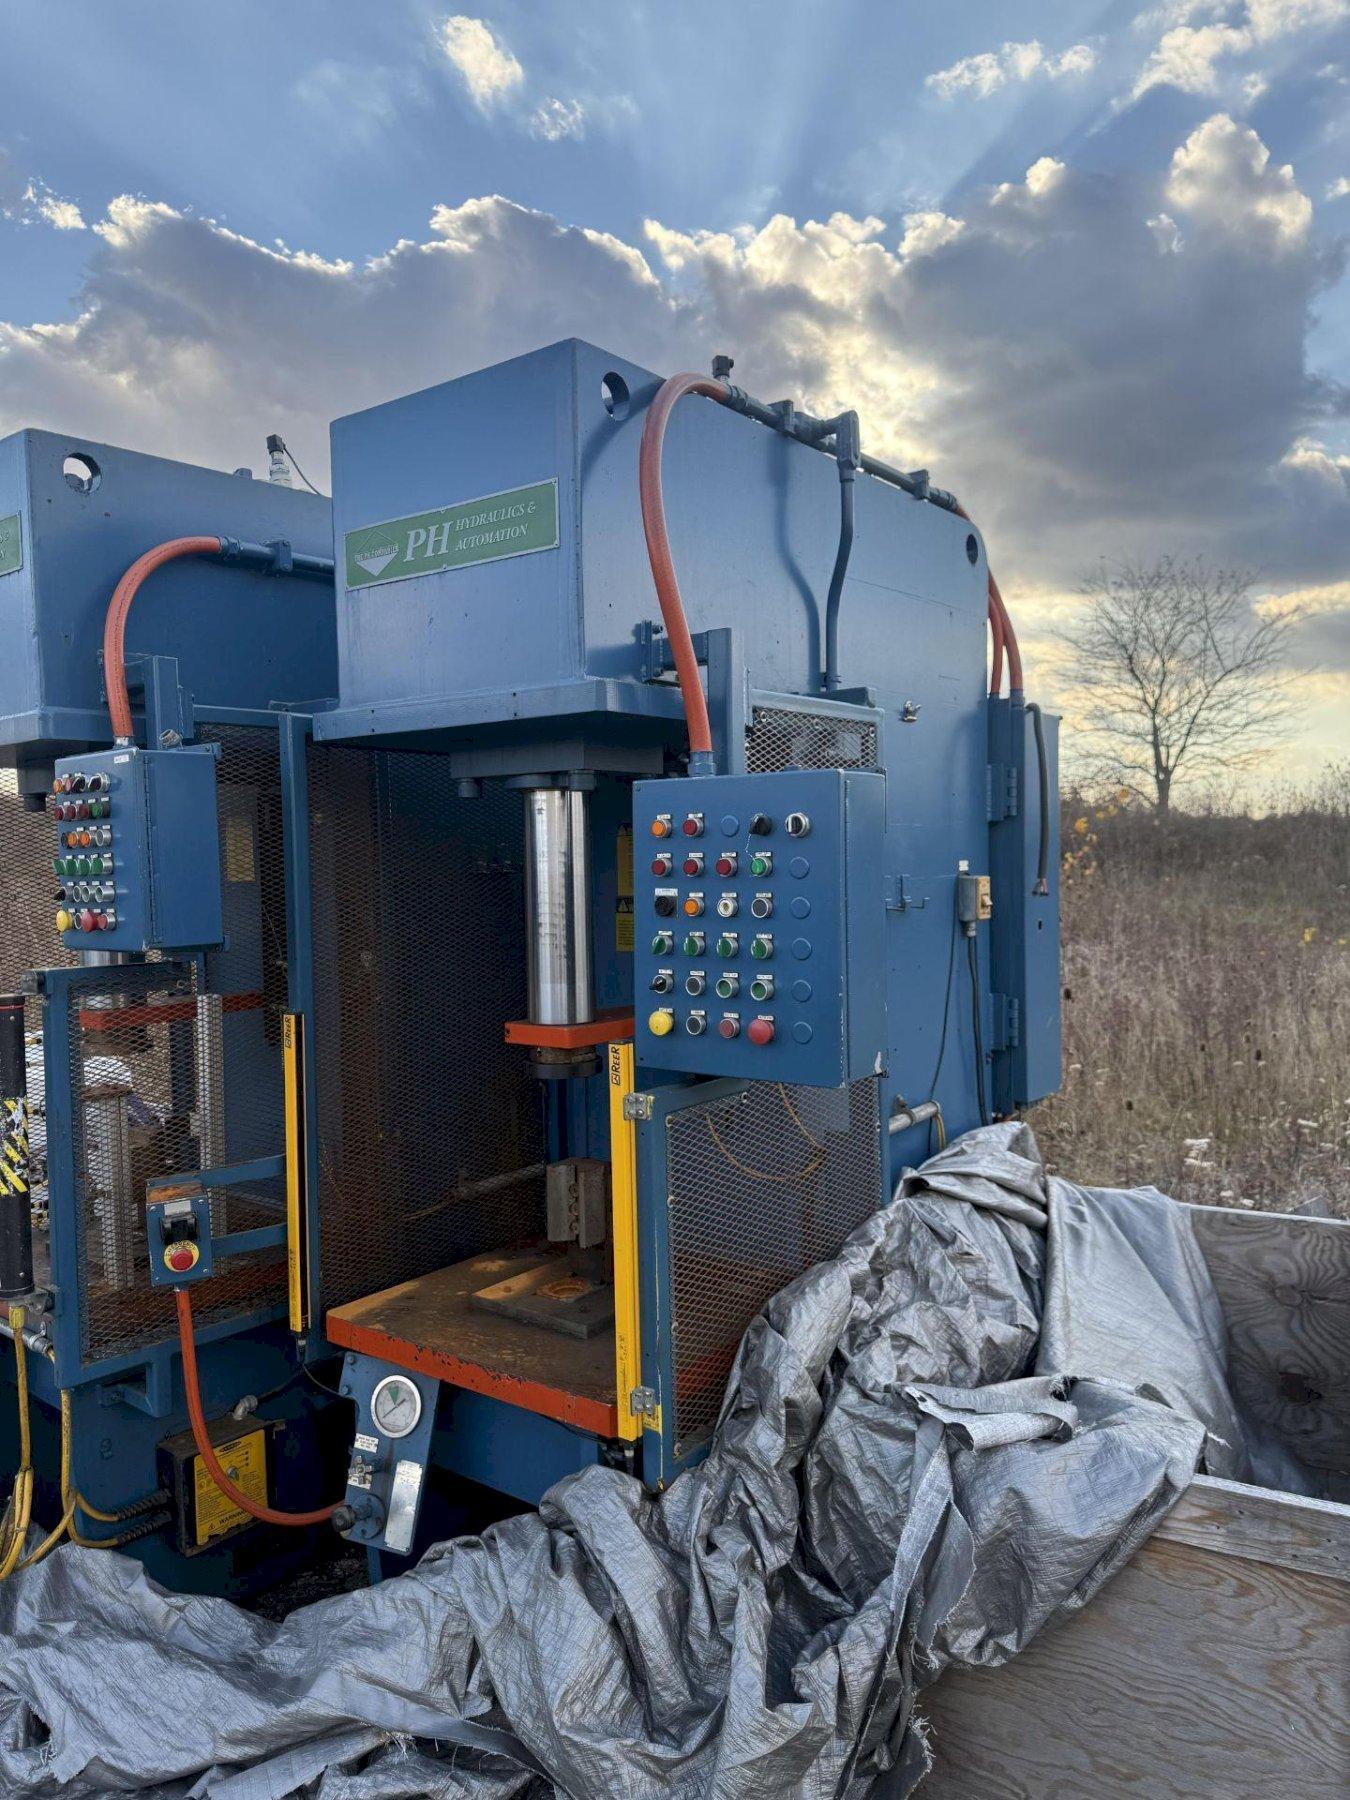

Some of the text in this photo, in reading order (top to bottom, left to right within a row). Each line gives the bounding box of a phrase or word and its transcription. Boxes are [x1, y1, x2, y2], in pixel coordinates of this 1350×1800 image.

[456, 501, 536, 531] HYDRAULICS &
[403, 521, 454, 562] PH
[456, 523, 528, 551] AUTOMATION
[611, 1046, 620, 1073] REER
